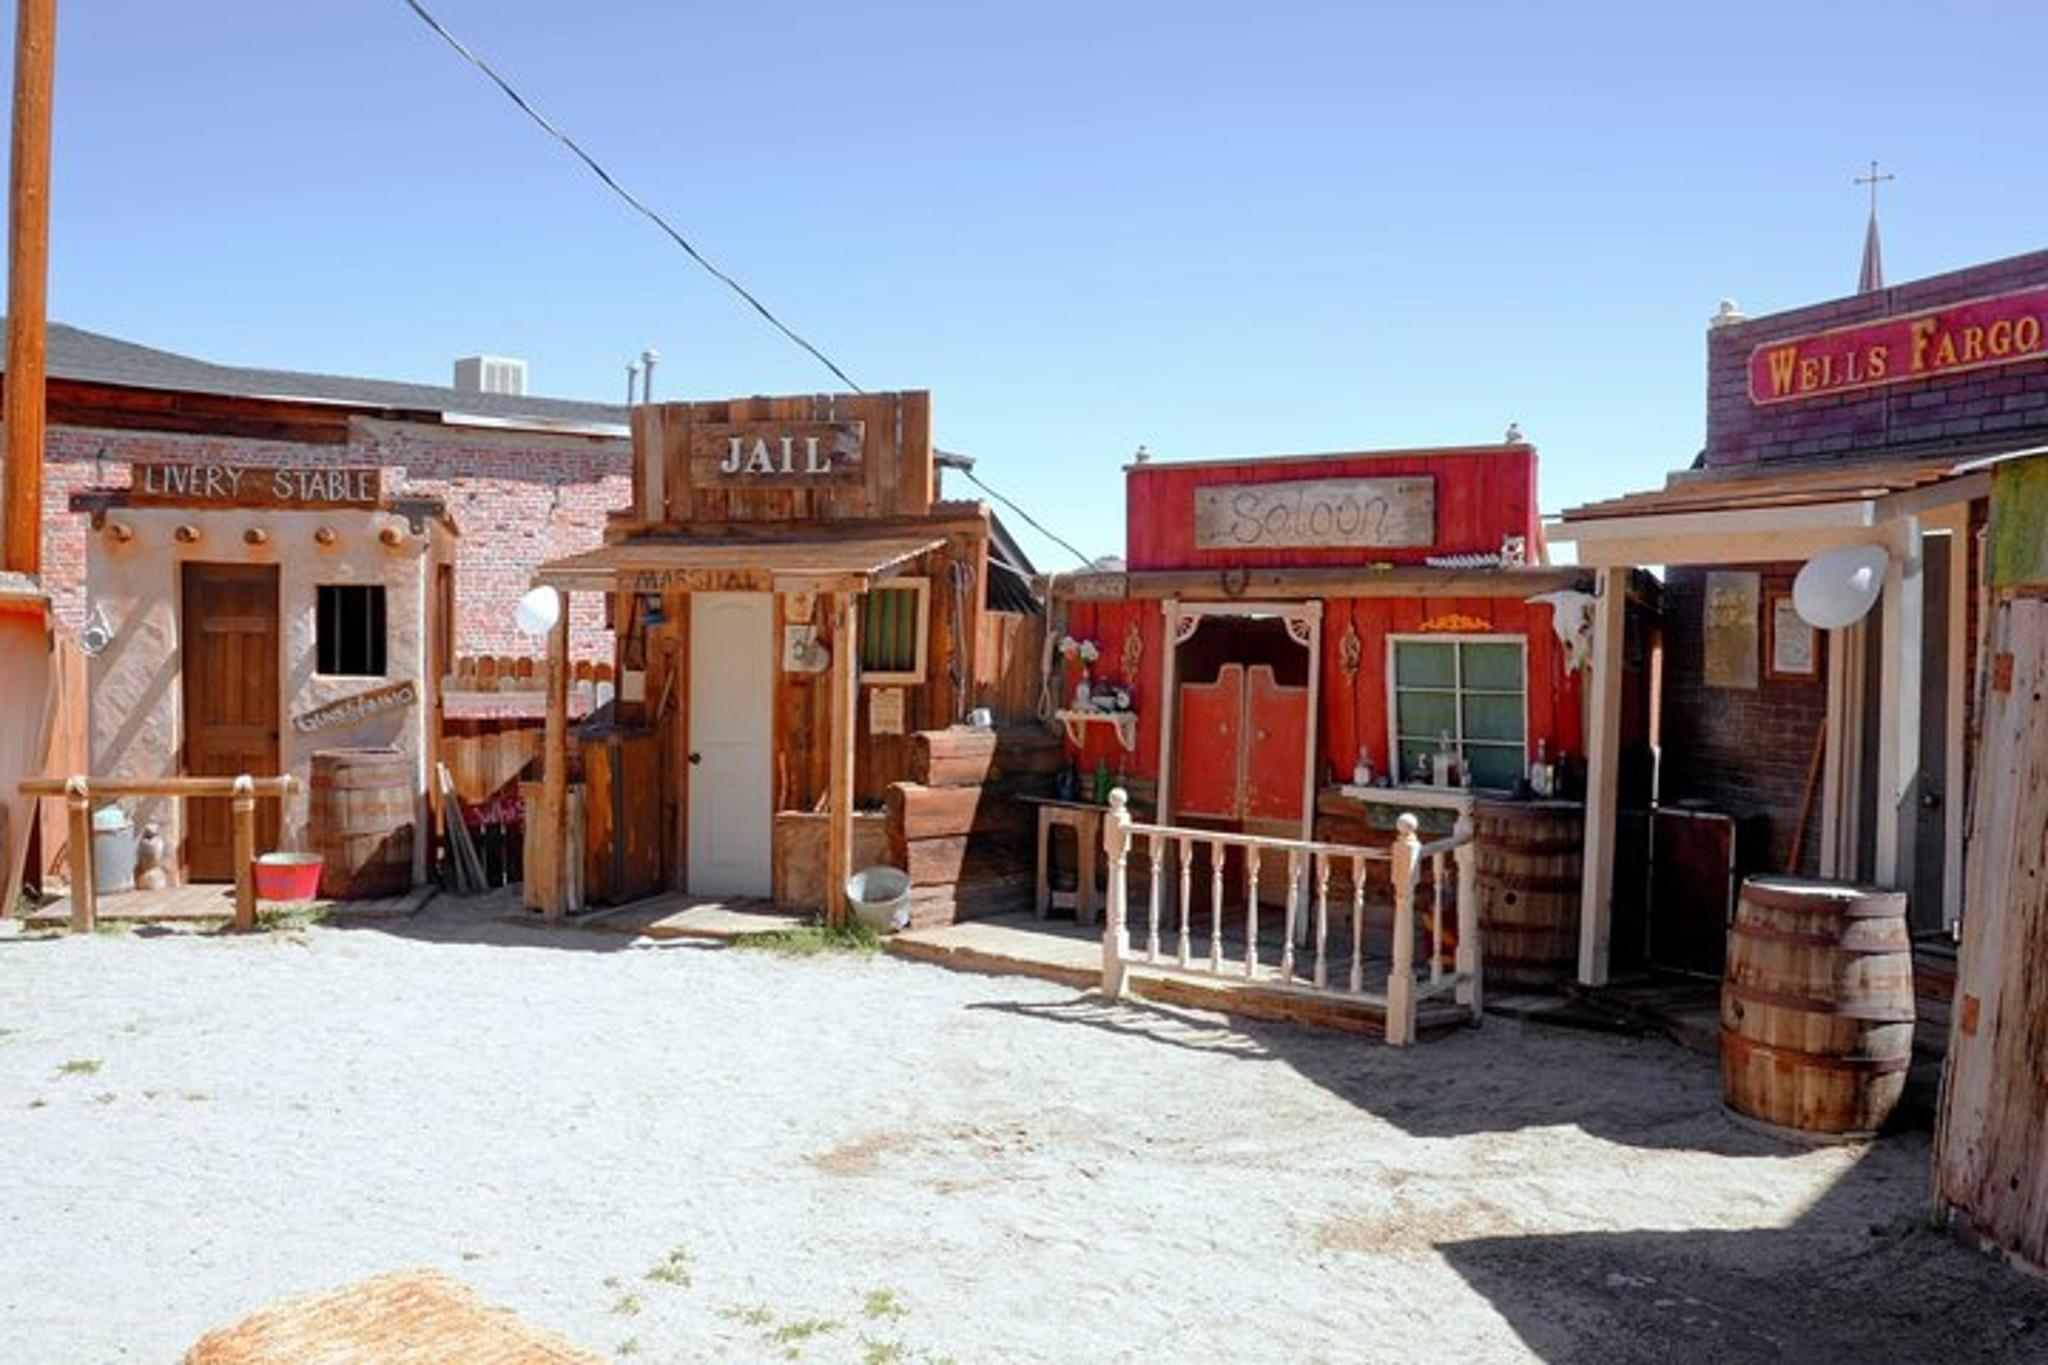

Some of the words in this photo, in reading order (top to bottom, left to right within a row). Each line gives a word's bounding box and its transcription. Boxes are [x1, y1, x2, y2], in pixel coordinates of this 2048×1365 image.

[1767, 346, 1888, 397] WELLS
[1910, 316, 2041, 371] FARGO
[721, 436, 831, 473] JAIL
[145, 465, 244, 497] LIVERY
[273, 469, 375, 501] STABLE
[1231, 488, 1388, 543] Saloon
